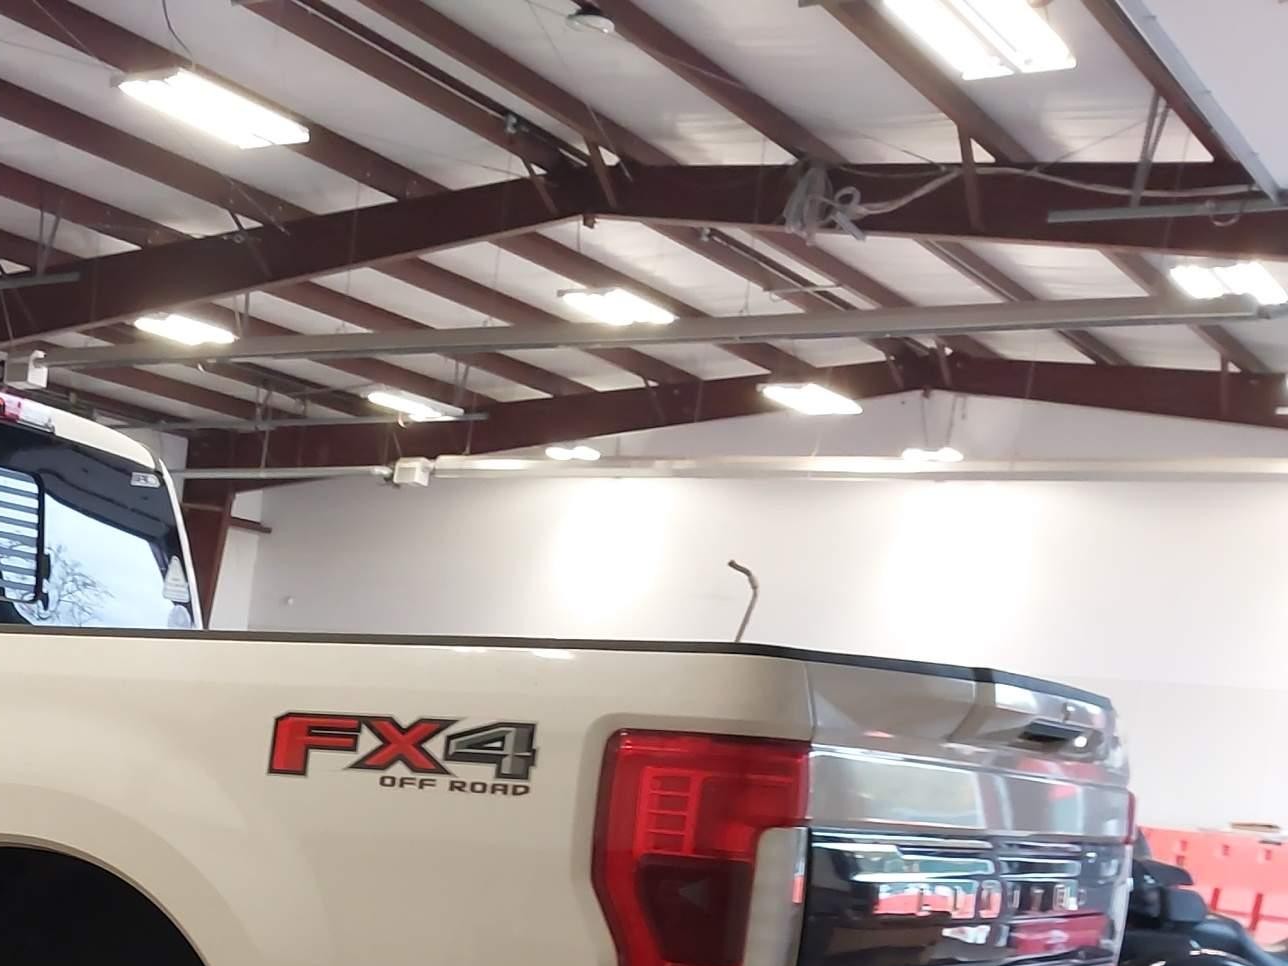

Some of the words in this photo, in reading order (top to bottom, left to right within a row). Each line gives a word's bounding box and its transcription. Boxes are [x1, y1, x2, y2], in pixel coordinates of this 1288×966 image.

[268, 711, 537, 780] FX4
[379, 776, 437, 790] OFF
[449, 780, 530, 796] ROAD
